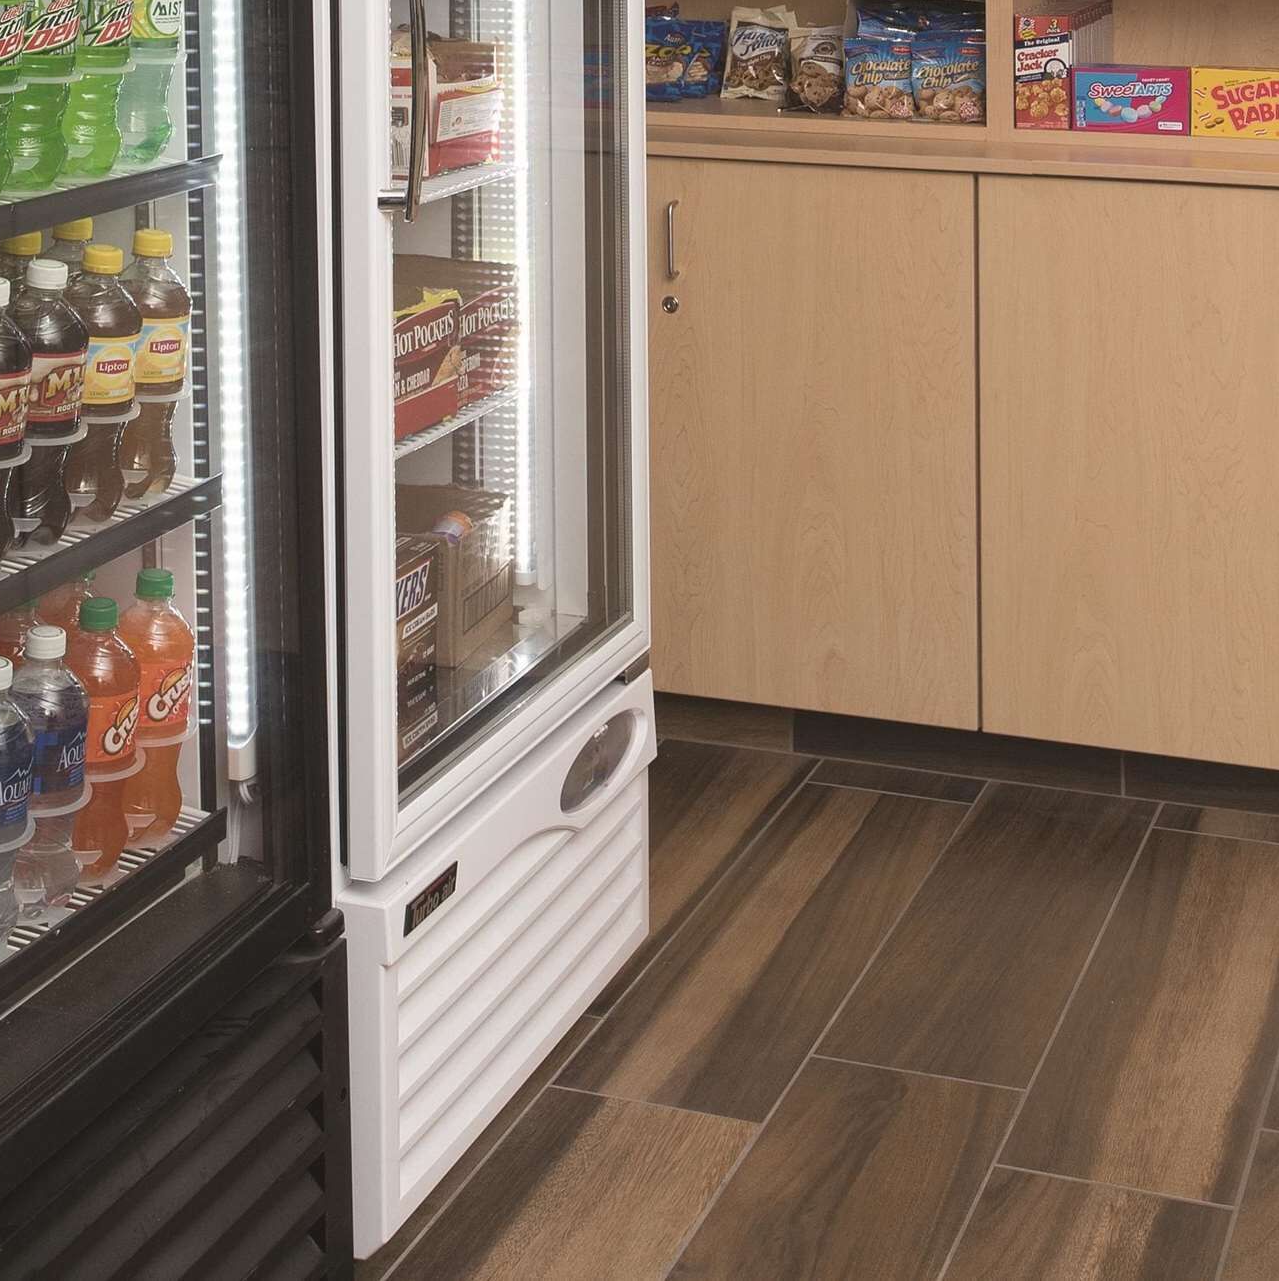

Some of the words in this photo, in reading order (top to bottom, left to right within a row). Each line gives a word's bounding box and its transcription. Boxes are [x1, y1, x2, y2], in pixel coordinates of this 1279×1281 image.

[1017, 48, 1060, 63] Cracker
[851, 59, 912, 75] Chocolate
[916, 60, 980, 79] Chocolate
[1017, 60, 1043, 73] Jack
[856, 71, 883, 86] Chip
[459, 312, 478, 338] HOT
[478, 296, 515, 329] POCKETS
[393, 331, 413, 360] HOT
[414, 309, 455, 350] POCKETS
[152, 340, 181, 353] Lipton
[99, 362, 128, 374] Lipton
[411, 891, 440, 930] Turbo
